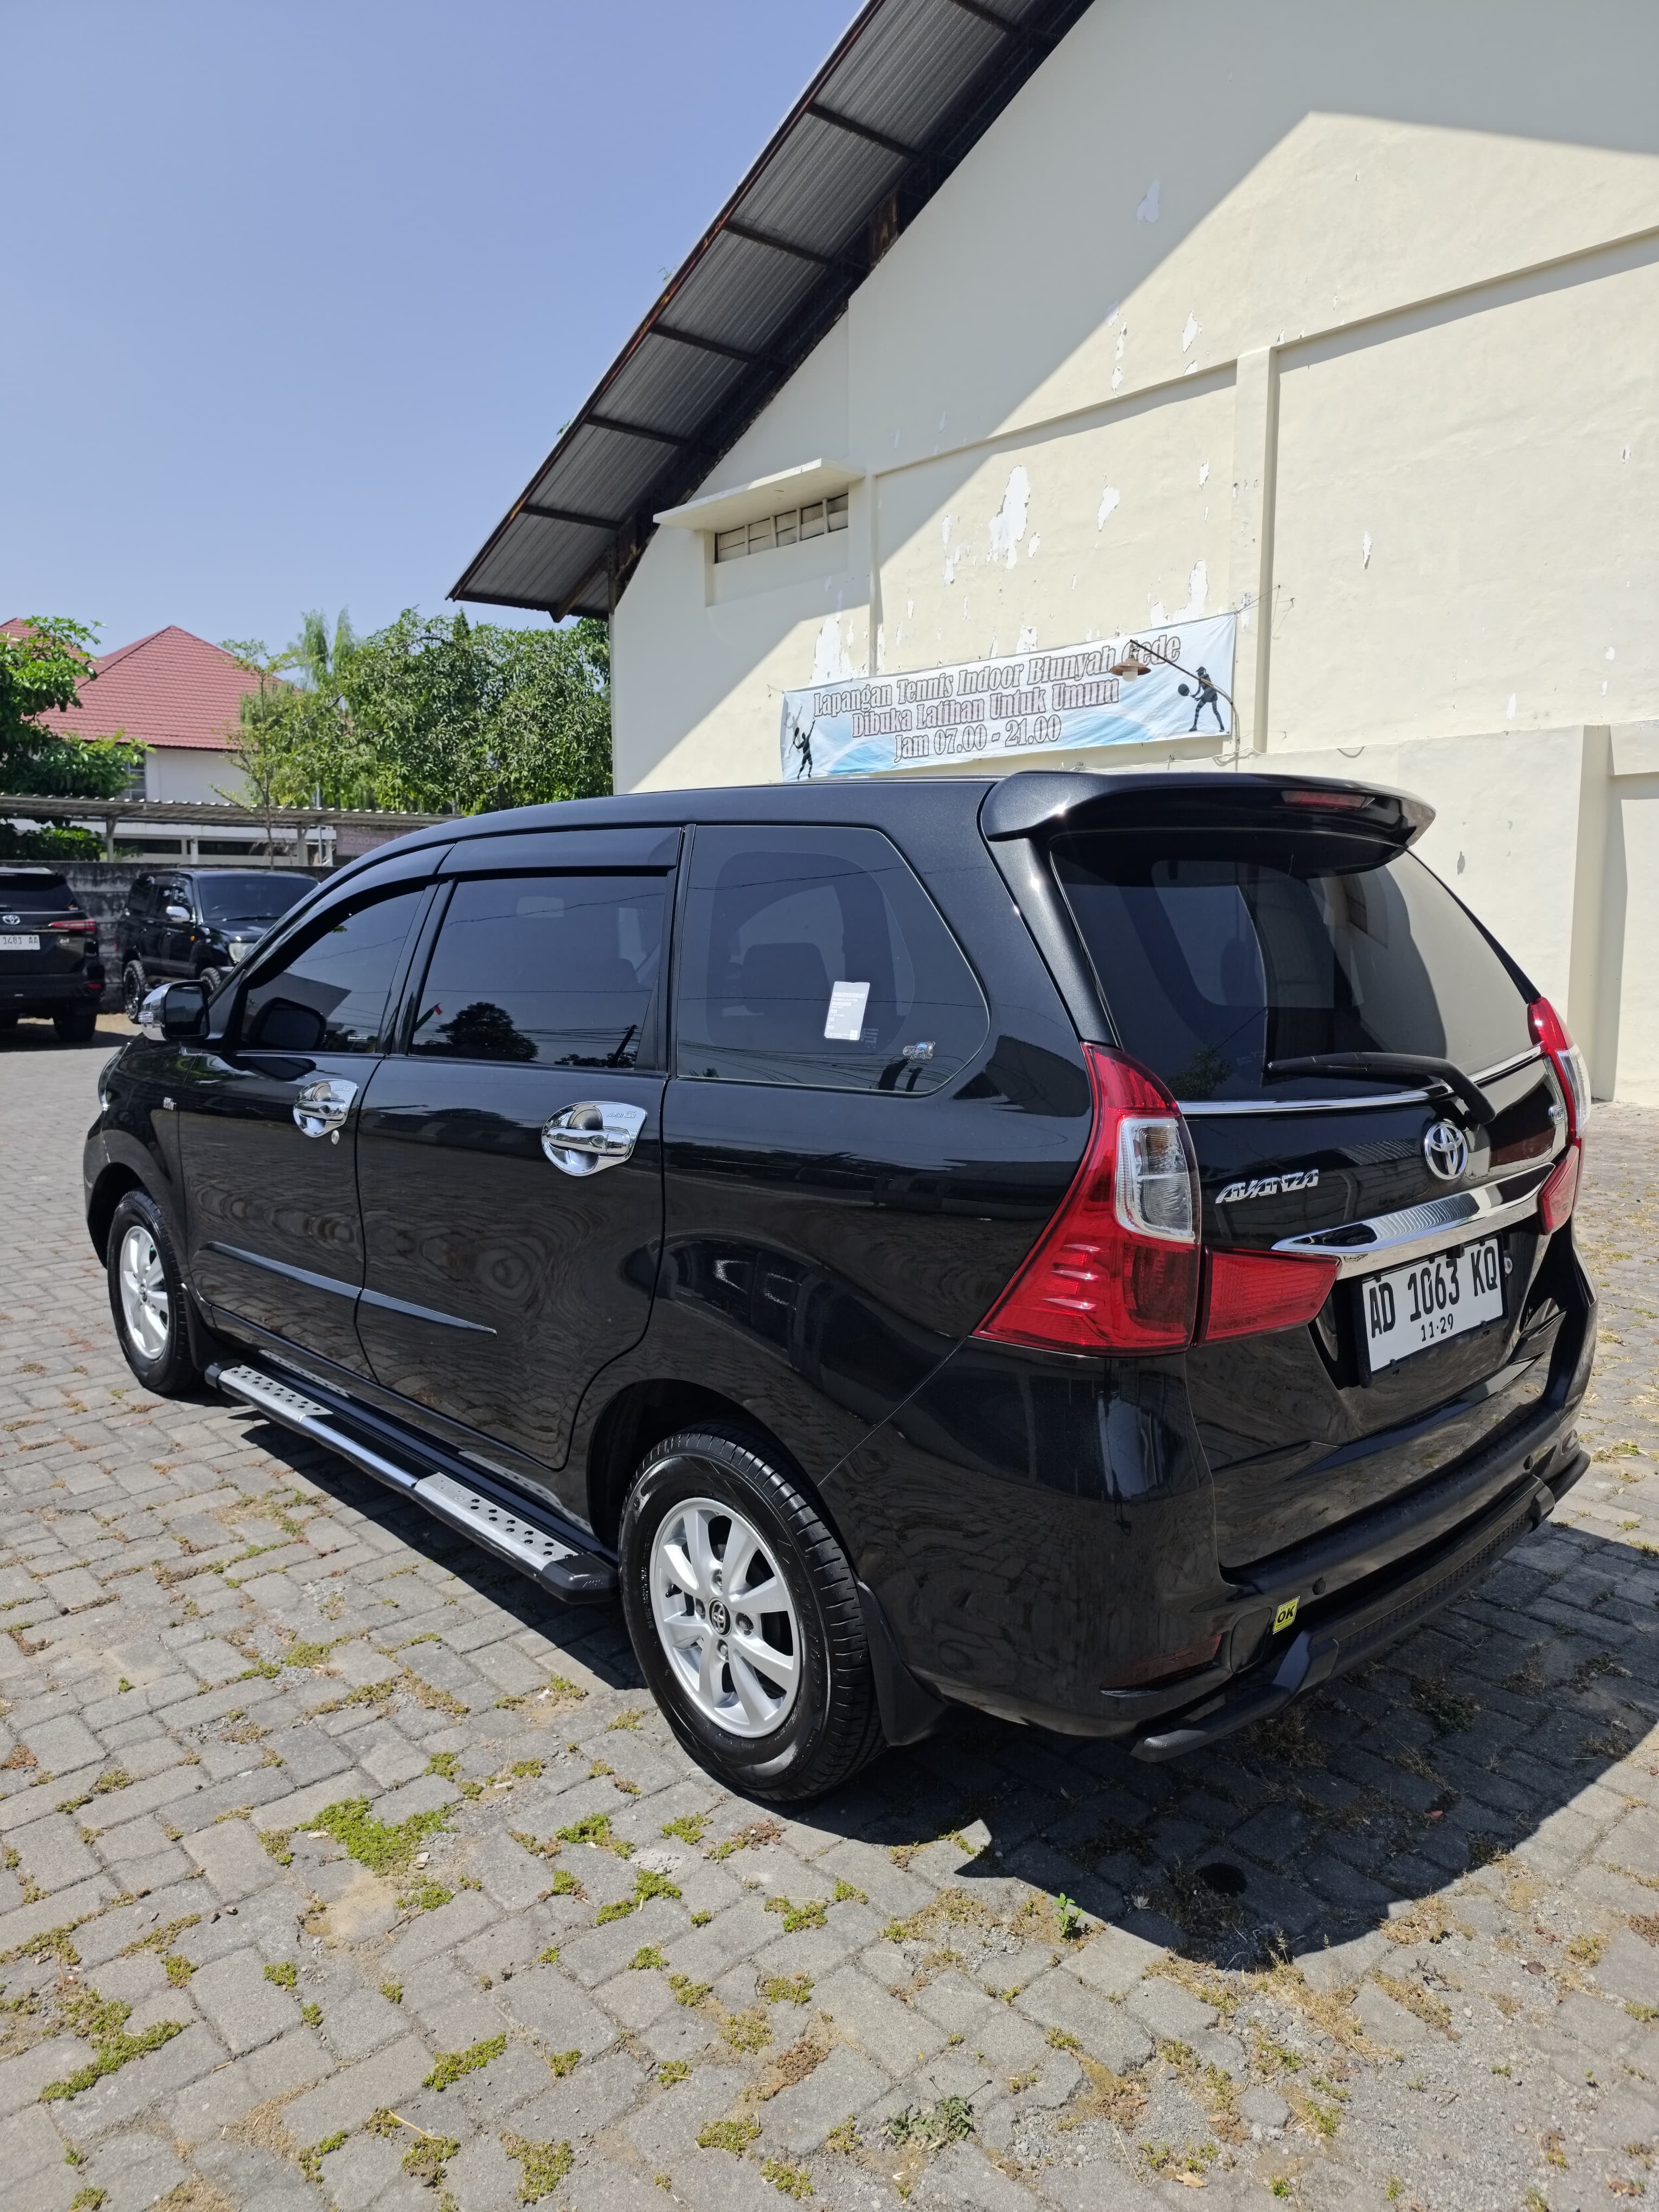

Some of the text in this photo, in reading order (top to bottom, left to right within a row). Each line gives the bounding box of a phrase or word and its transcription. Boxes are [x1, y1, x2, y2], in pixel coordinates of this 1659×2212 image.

[813, 683, 892, 717] Lapangan
[897, 673, 954, 704] Tennis
[957, 663, 1024, 696] Indoor
[1027, 646, 1116, 685] Blunyah
[852, 678, 1120, 738] Dibuka Latihan Untuk Umum
[894, 734, 929, 763] Jam
[934, 724, 987, 755] 07.00
[1005, 714, 1062, 748] 21.00
[1215, 1169, 1319, 1204] AVANZA
[1369, 1246, 1498, 1339] AD 1063 KQ
[1277, 1604, 1296, 1623] OK
